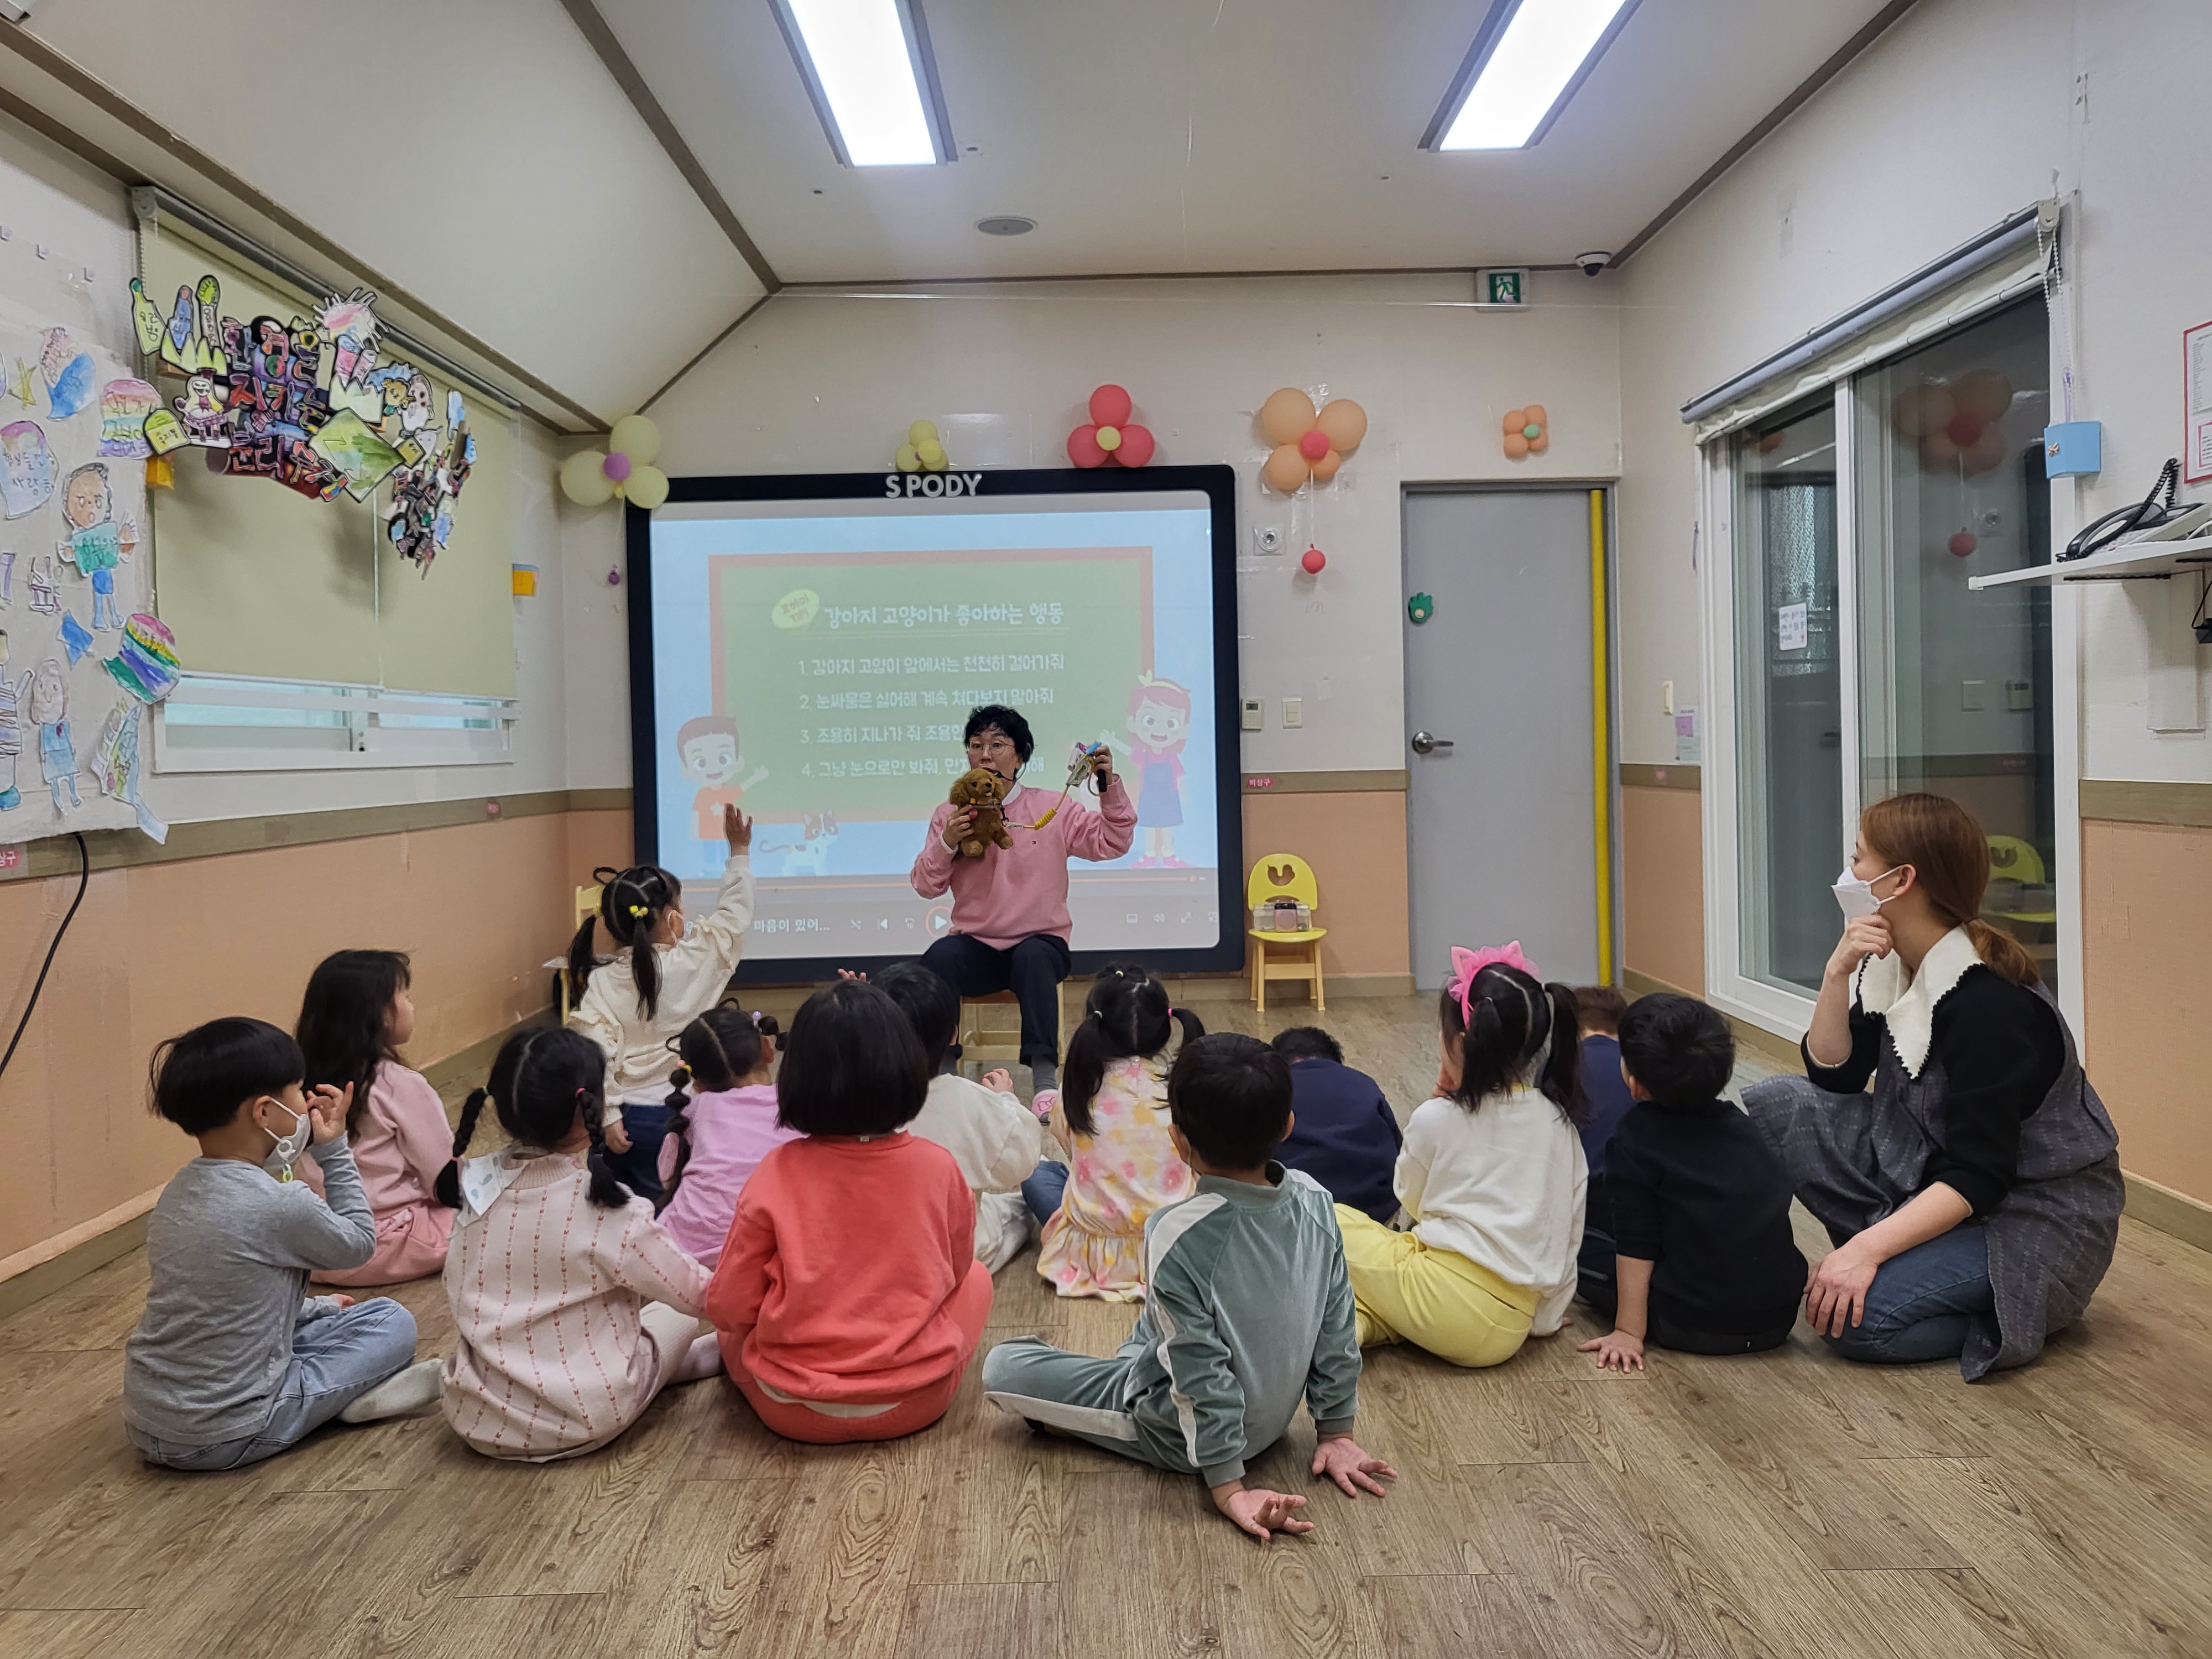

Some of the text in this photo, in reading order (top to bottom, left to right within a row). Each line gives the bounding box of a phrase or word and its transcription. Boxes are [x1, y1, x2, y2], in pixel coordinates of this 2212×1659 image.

[824, 602, 1064, 629] 강아지 고양이가 좋아하는 행동
[812, 659, 855, 676] 강아지
[859, 657, 900, 675] 고양이
[904, 656, 959, 673] 앞에서는
[964, 655, 1004, 672] 천천히
[1009, 653, 1064, 671] 걸어가줘
[816, 692, 873, 709] 눈싸움은
[877, 691, 917, 708] 싫어해
[921, 691, 948, 707] 계속
[952, 690, 1007, 706] 쳐다보지
[1011, 688, 1053, 705] 말아줘
[817, 727, 857, 743] 조용히
[861, 726, 902, 742] 지나가
[907, 725, 920, 742] 줘
[819, 761, 846, 777] 그냥
[850, 759, 905, 776] 눈으로만
[754, 918, 830, 933] 마음이 있어...
